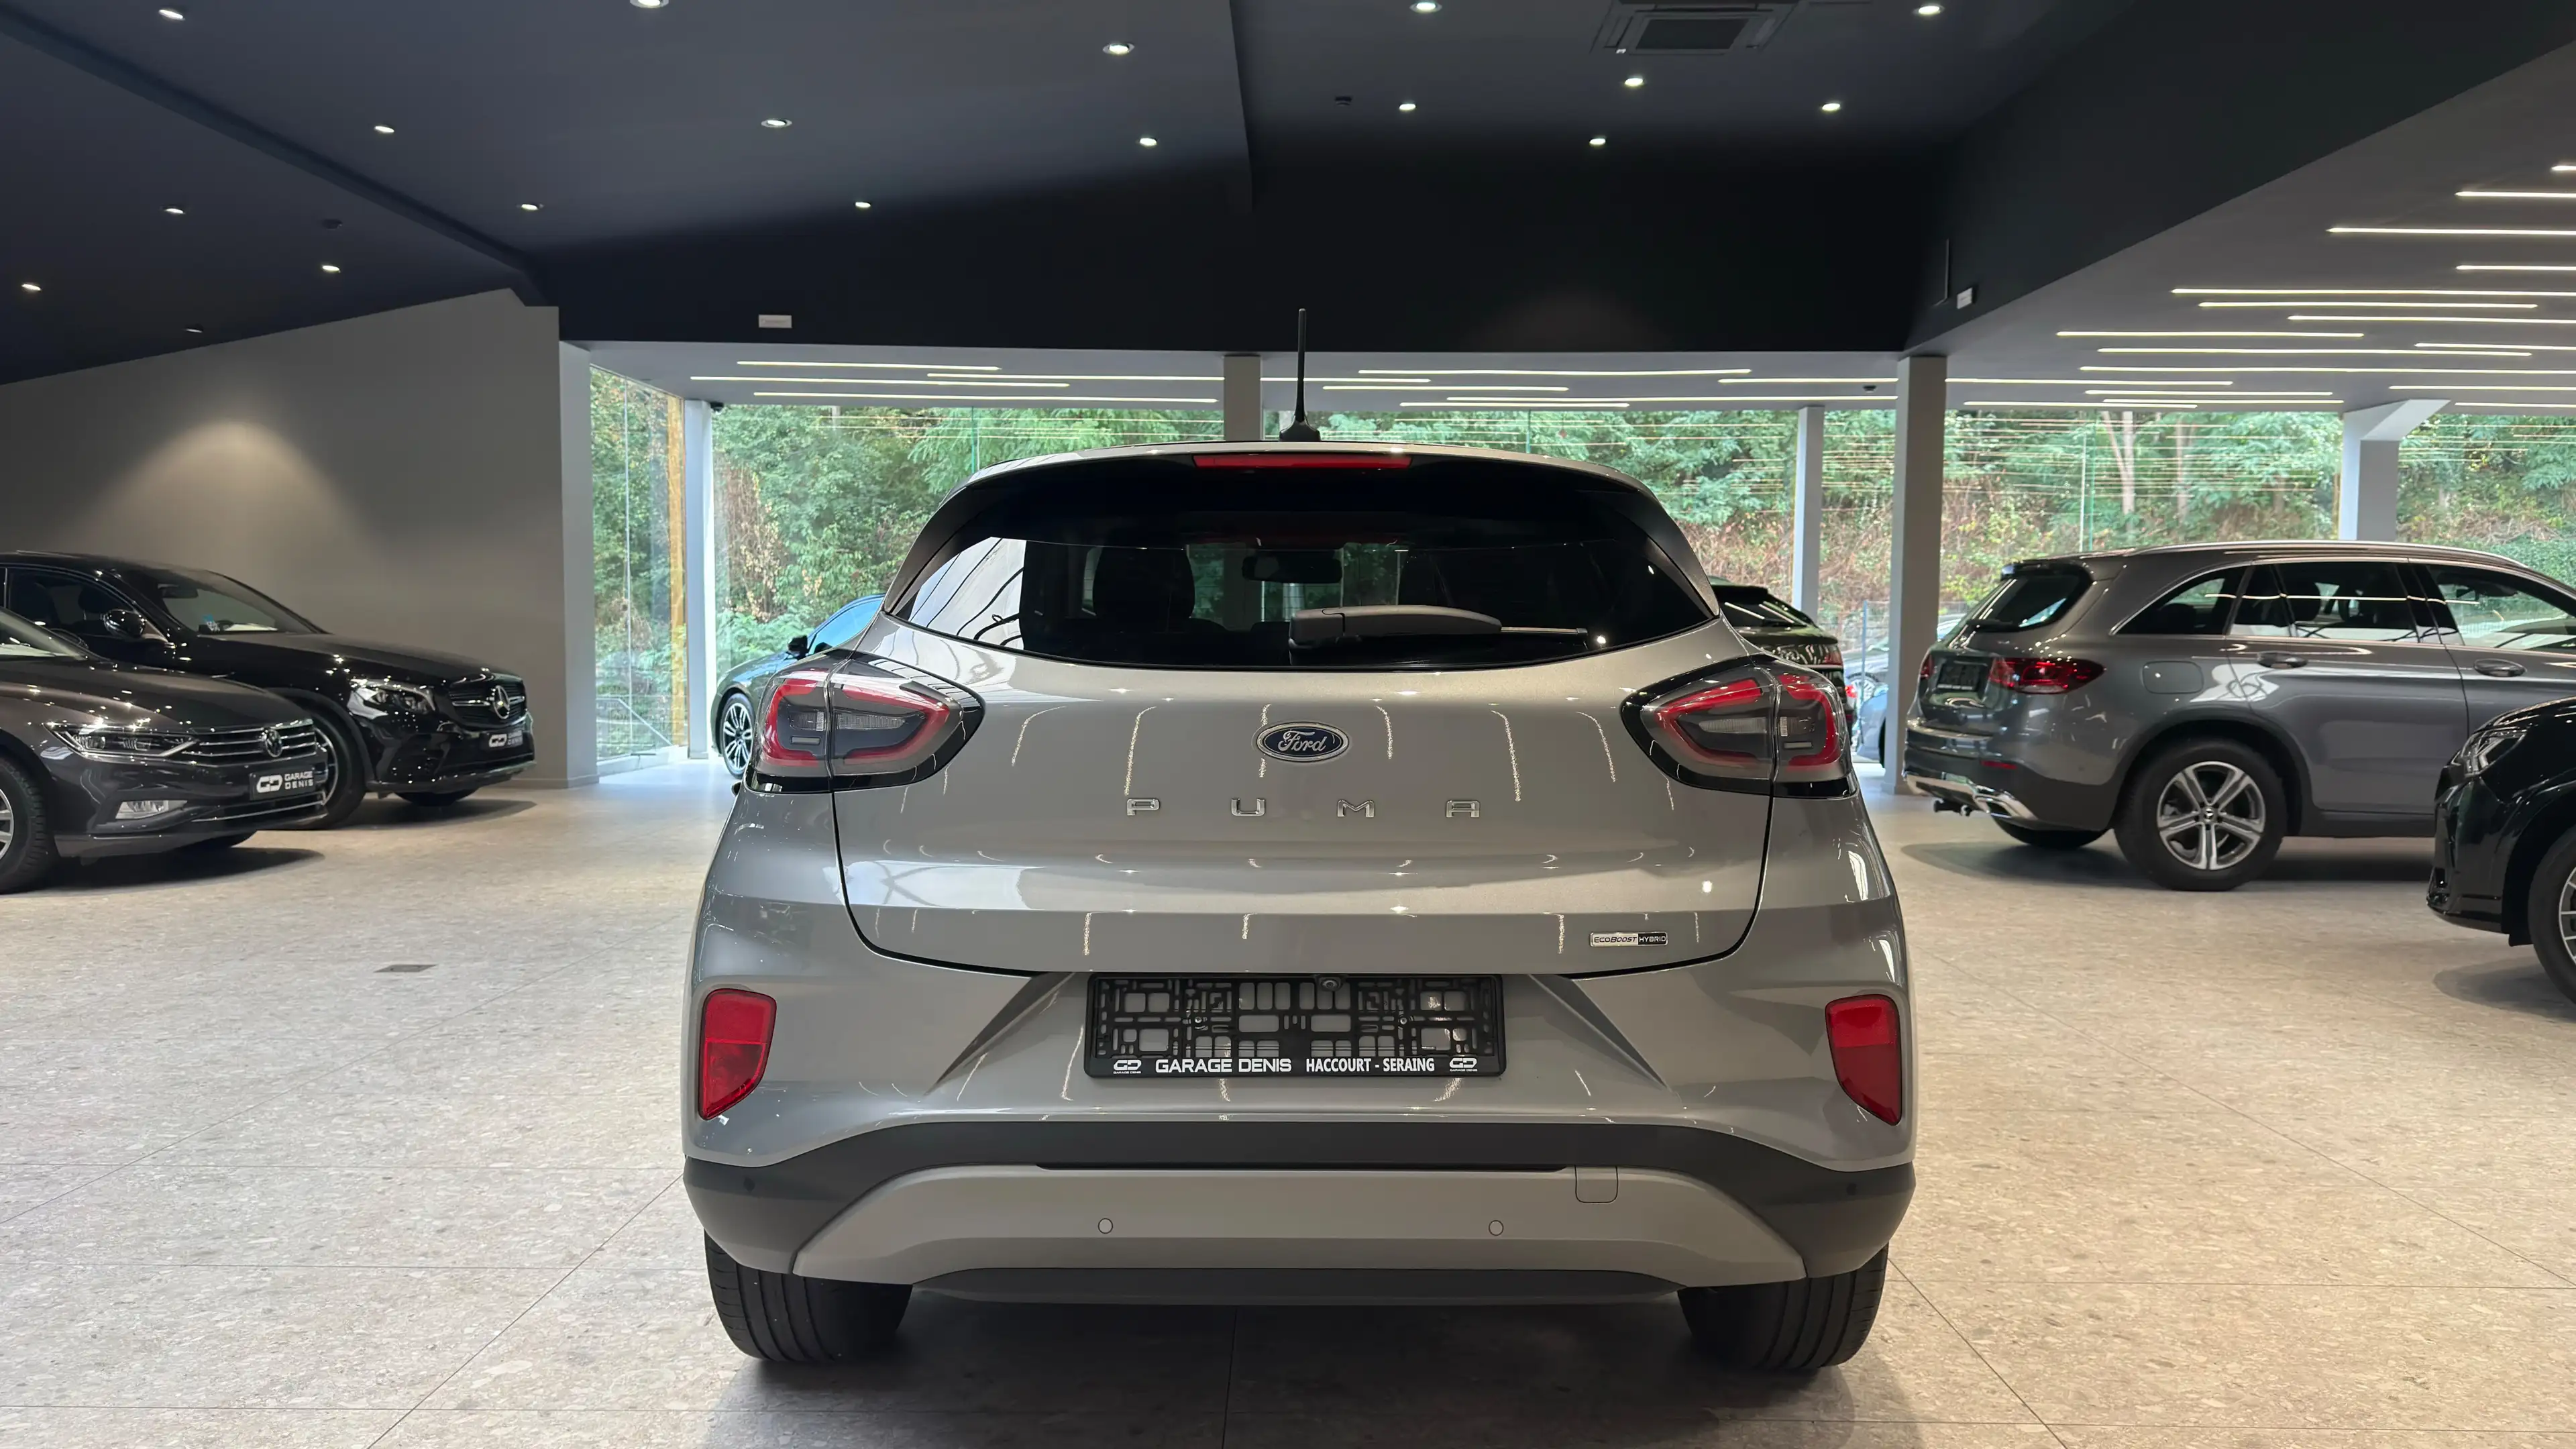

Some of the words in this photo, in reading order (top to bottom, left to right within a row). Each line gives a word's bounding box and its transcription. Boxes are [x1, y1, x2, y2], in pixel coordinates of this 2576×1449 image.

[1278, 730, 1328, 751] Ford
[284, 771, 313, 782] GARAGE
[284, 778, 314, 790] DENIS
[1126, 798, 1481, 818] PUMA
[1155, 1059, 1232, 1073] GARAGE
[1238, 1059, 1292, 1072] DENIS
[1306, 1058, 1372, 1072] HACCOURT
[1383, 1058, 1435, 1072] SERAING
